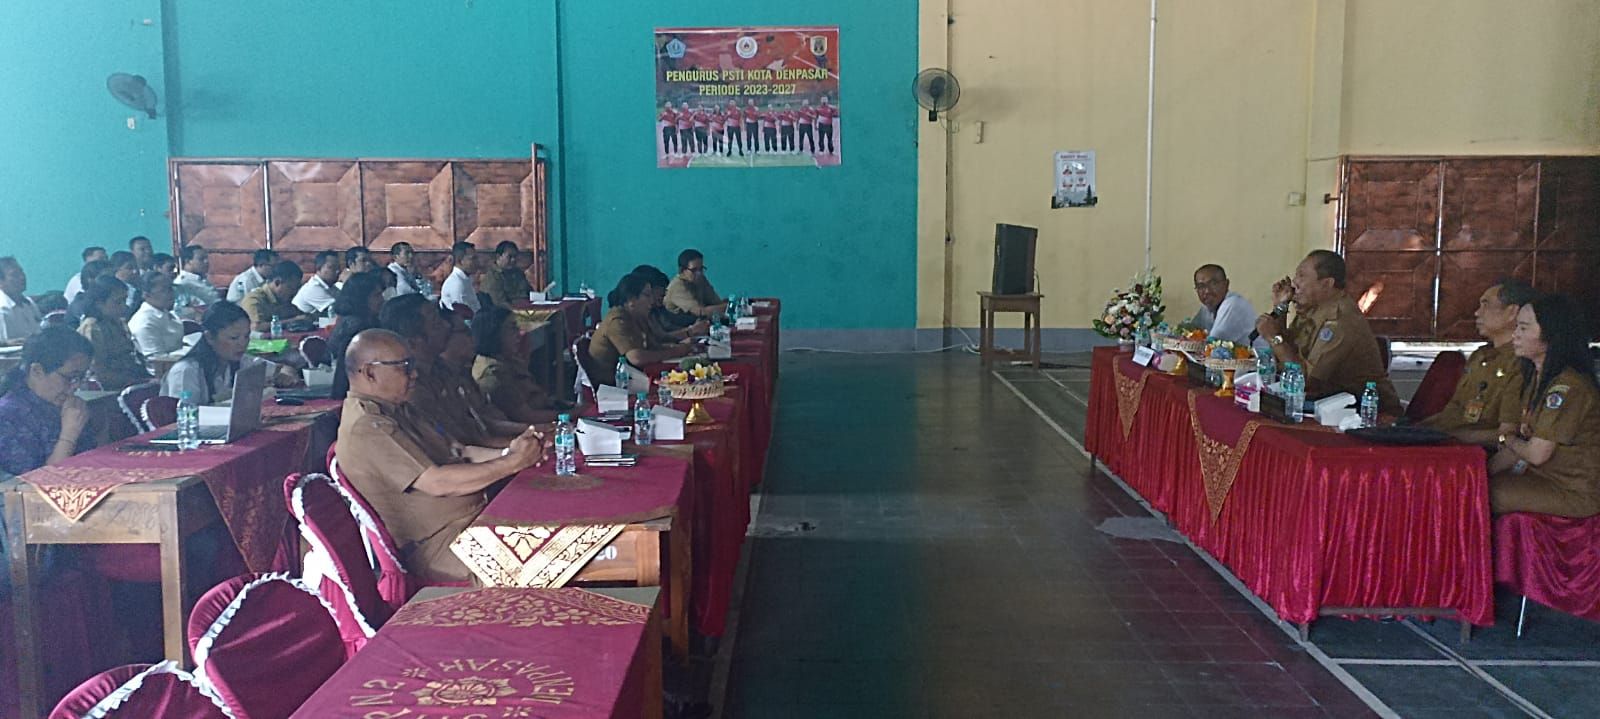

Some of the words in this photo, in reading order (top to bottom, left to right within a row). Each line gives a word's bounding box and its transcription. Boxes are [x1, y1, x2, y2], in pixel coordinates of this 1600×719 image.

[666, 70, 718, 82] PENGURUS
[722, 70, 744, 81] PSTI
[748, 70, 772, 81] KOTA
[776, 69, 829, 80] DENPASAR
[699, 85, 741, 96] PERIODE
[744, 84, 796, 96] 2023-2027
